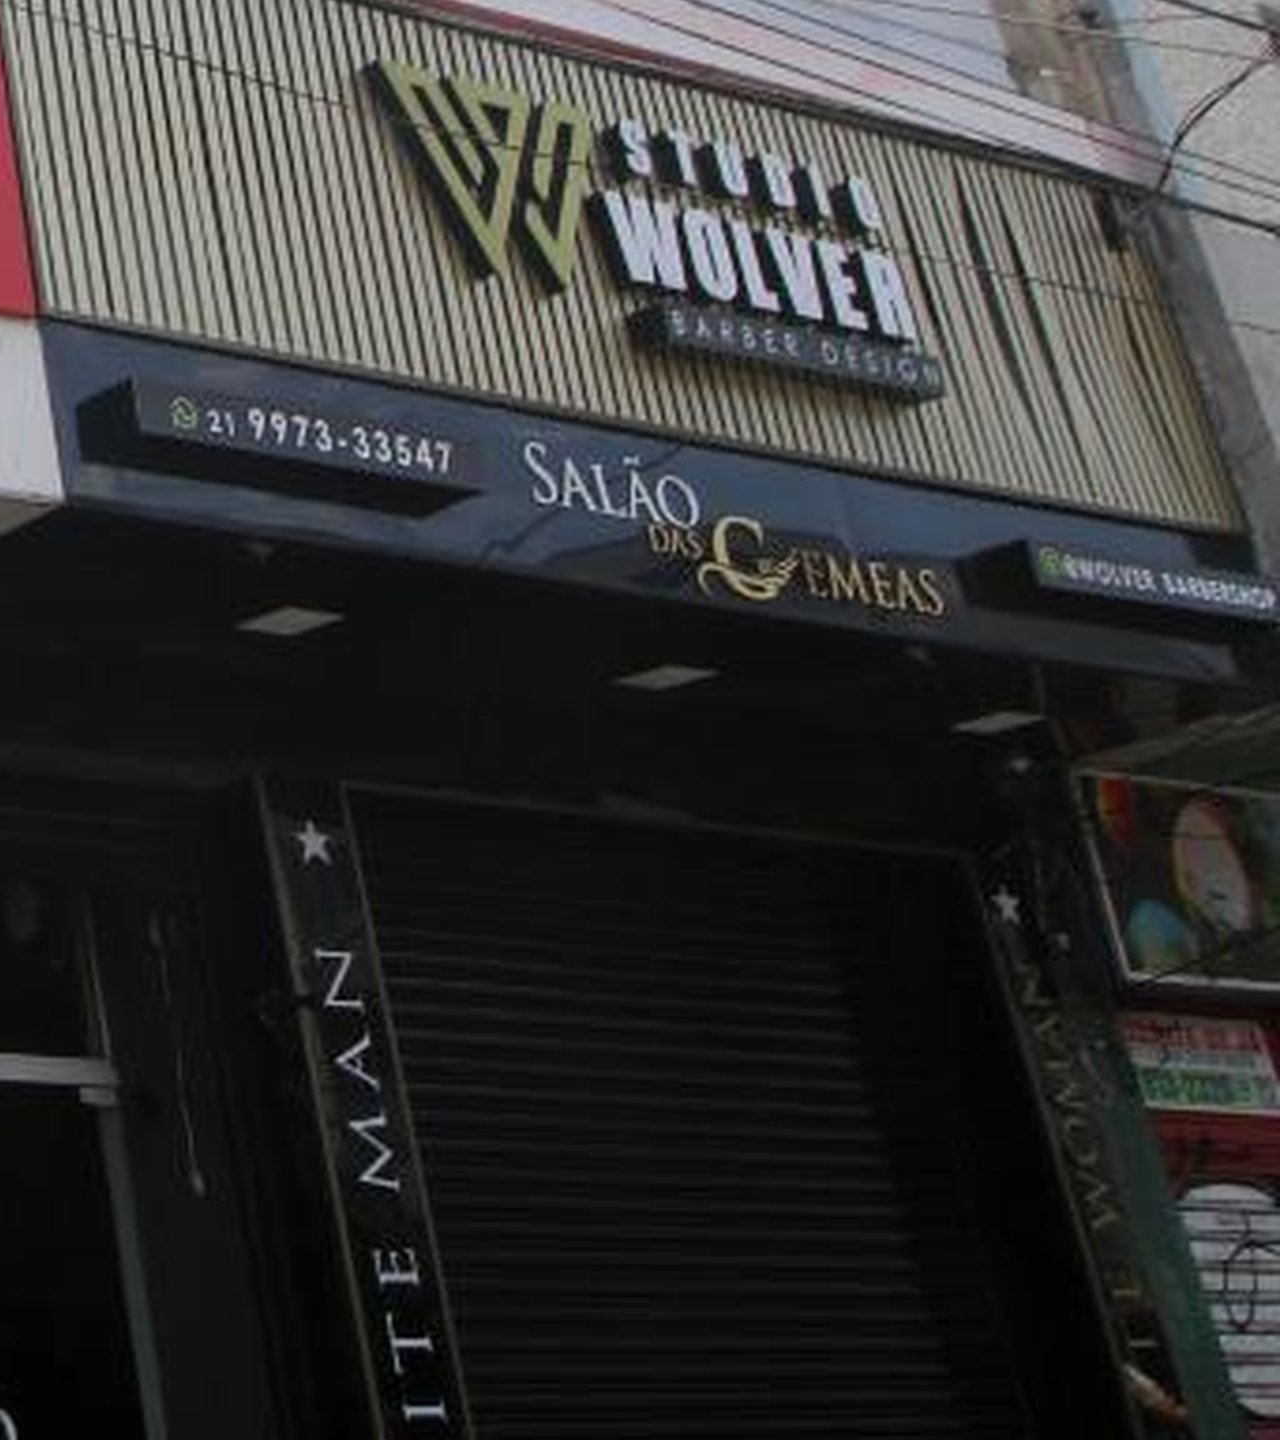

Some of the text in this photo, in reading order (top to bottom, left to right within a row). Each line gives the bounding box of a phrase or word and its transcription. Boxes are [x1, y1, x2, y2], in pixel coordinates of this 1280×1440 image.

[616, 117, 883, 232] STUDIO
[600, 186, 920, 347] WOLVER
[669, 308, 942, 389] BARBER DESIGN
[206, 407, 454, 474] 21 9973-33547
[522, 440, 701, 531] SALÃO
[646, 523, 704, 561] DAS
[312, 946, 401, 1193] MAN
